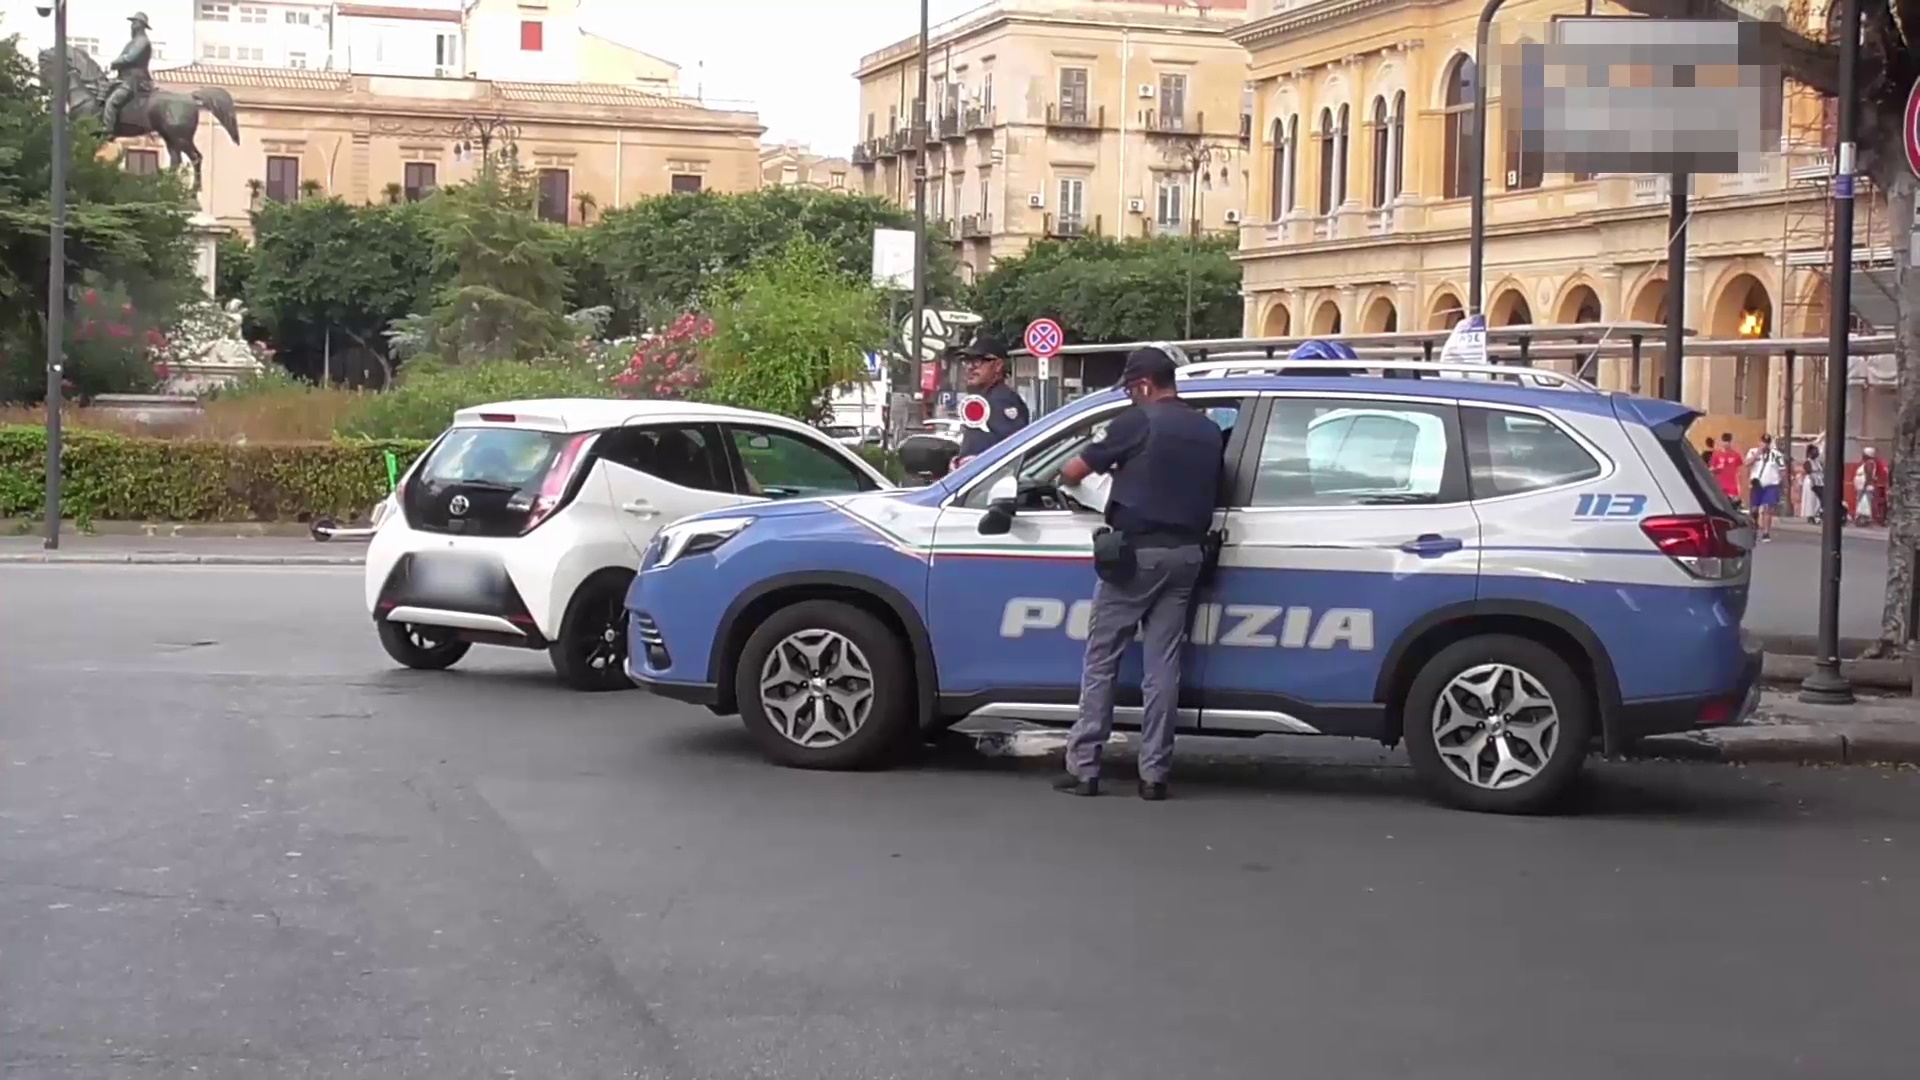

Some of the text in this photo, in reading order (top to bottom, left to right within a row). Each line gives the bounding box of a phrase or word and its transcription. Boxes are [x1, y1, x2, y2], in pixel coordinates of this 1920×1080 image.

[943, 392, 951, 408] P
[1574, 493, 1647, 516] 113
[1000, 597, 1375, 651] PIZIA
